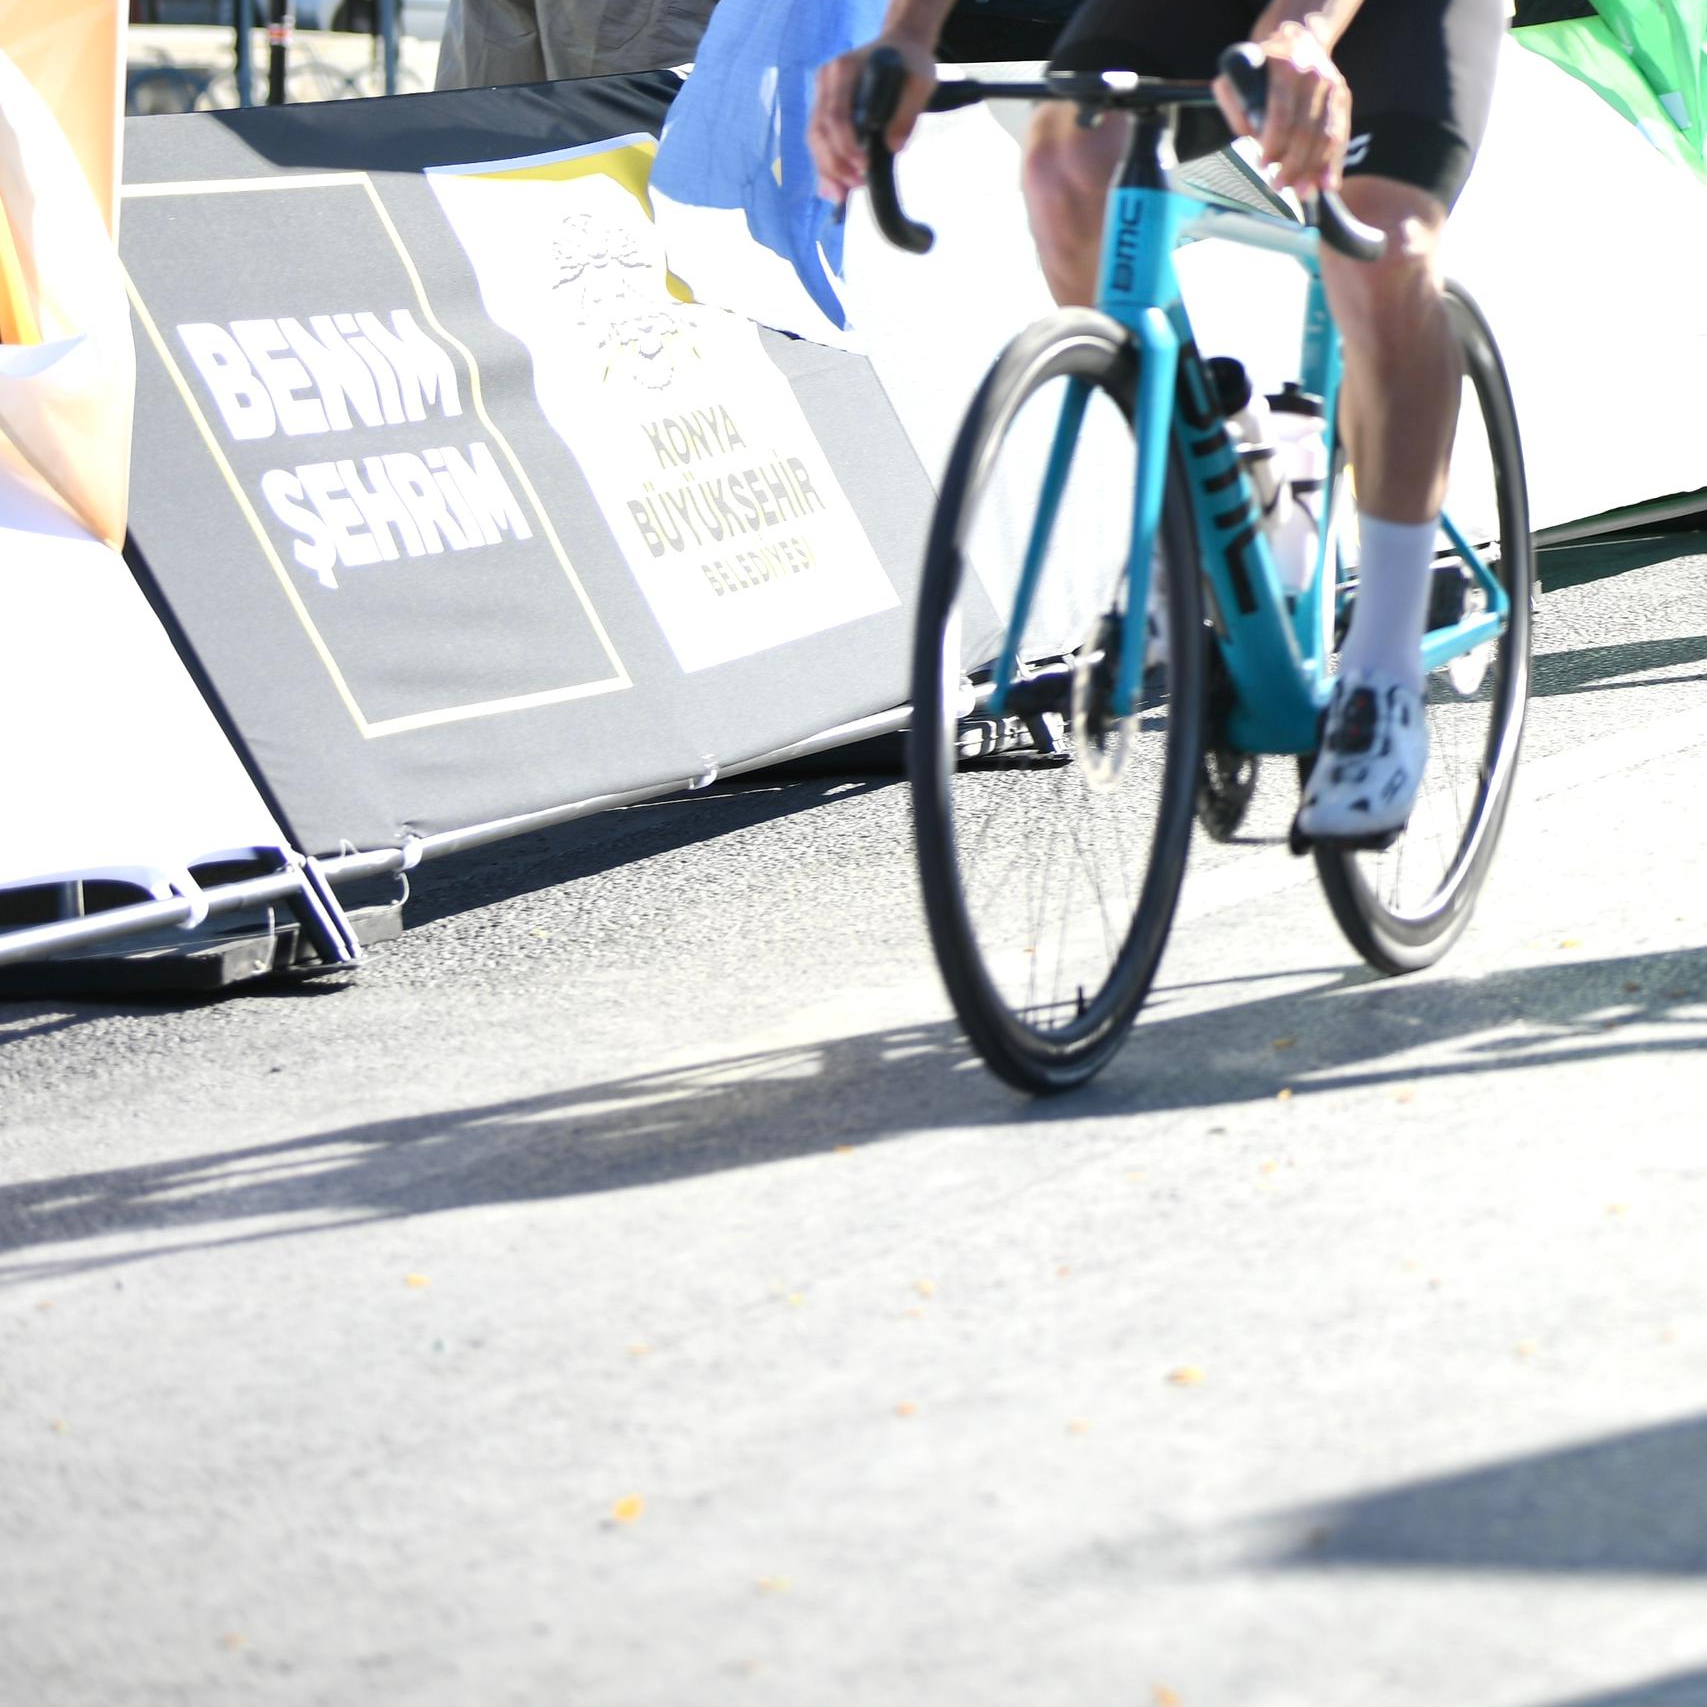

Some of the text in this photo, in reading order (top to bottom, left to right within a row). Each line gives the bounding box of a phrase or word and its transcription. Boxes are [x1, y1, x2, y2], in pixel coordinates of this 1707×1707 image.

[178, 307, 464, 442] BENİM
[640, 404, 747, 470] KONYA
[261, 440, 534, 590] ŞEHRİM
